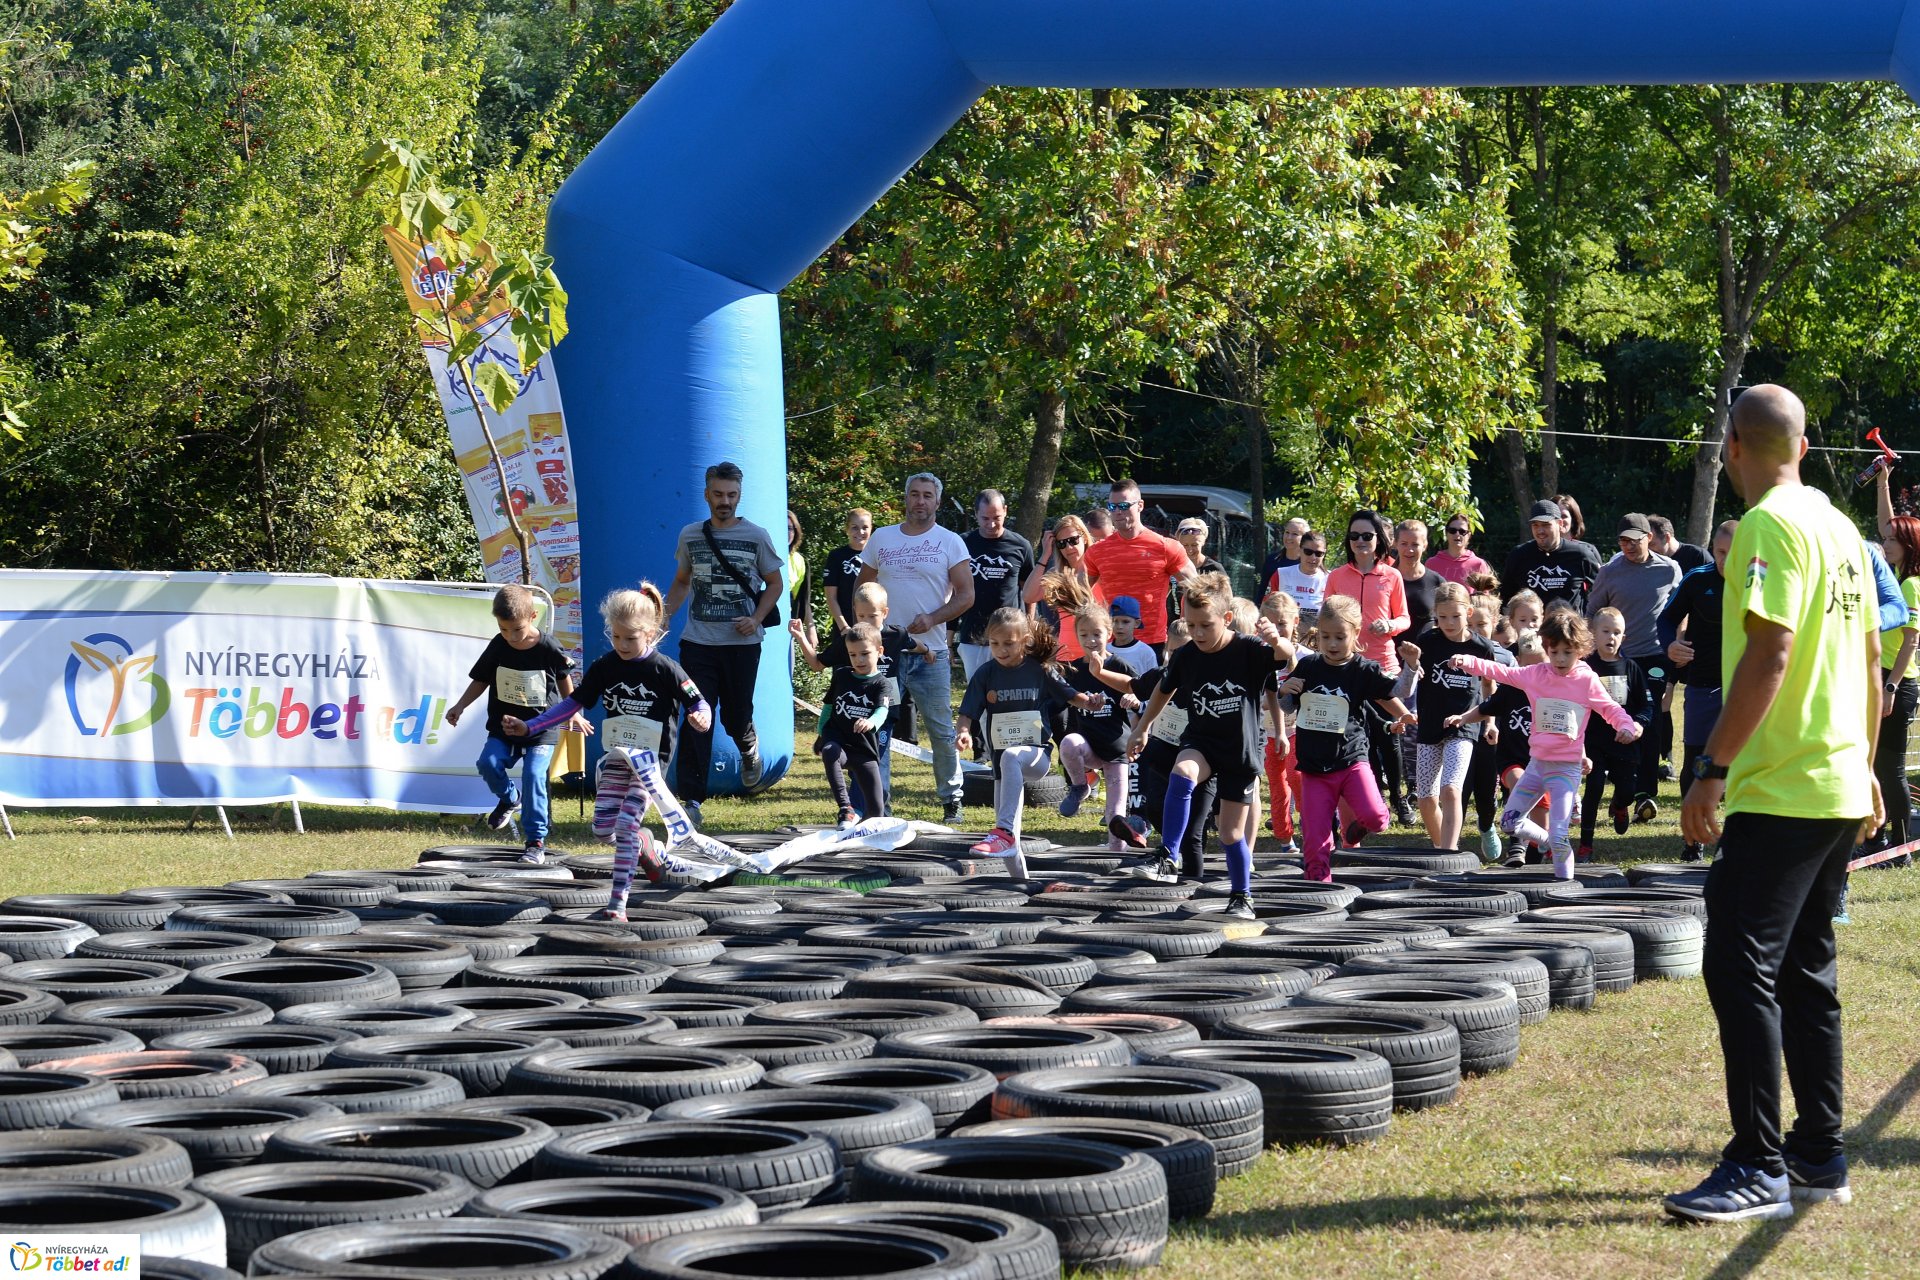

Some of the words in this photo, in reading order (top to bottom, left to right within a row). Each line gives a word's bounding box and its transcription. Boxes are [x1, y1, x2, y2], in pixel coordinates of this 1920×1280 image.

[185, 646, 381, 680] NYÍREGYHÁZA
[997, 688, 1039, 701] SPARTAN
[184, 686, 365, 740] Többet
[375, 694, 447, 745] ad!
[1315, 709, 1327, 717] 010
[623, 732, 637, 740] 032
[1008, 727, 1021, 735] 083
